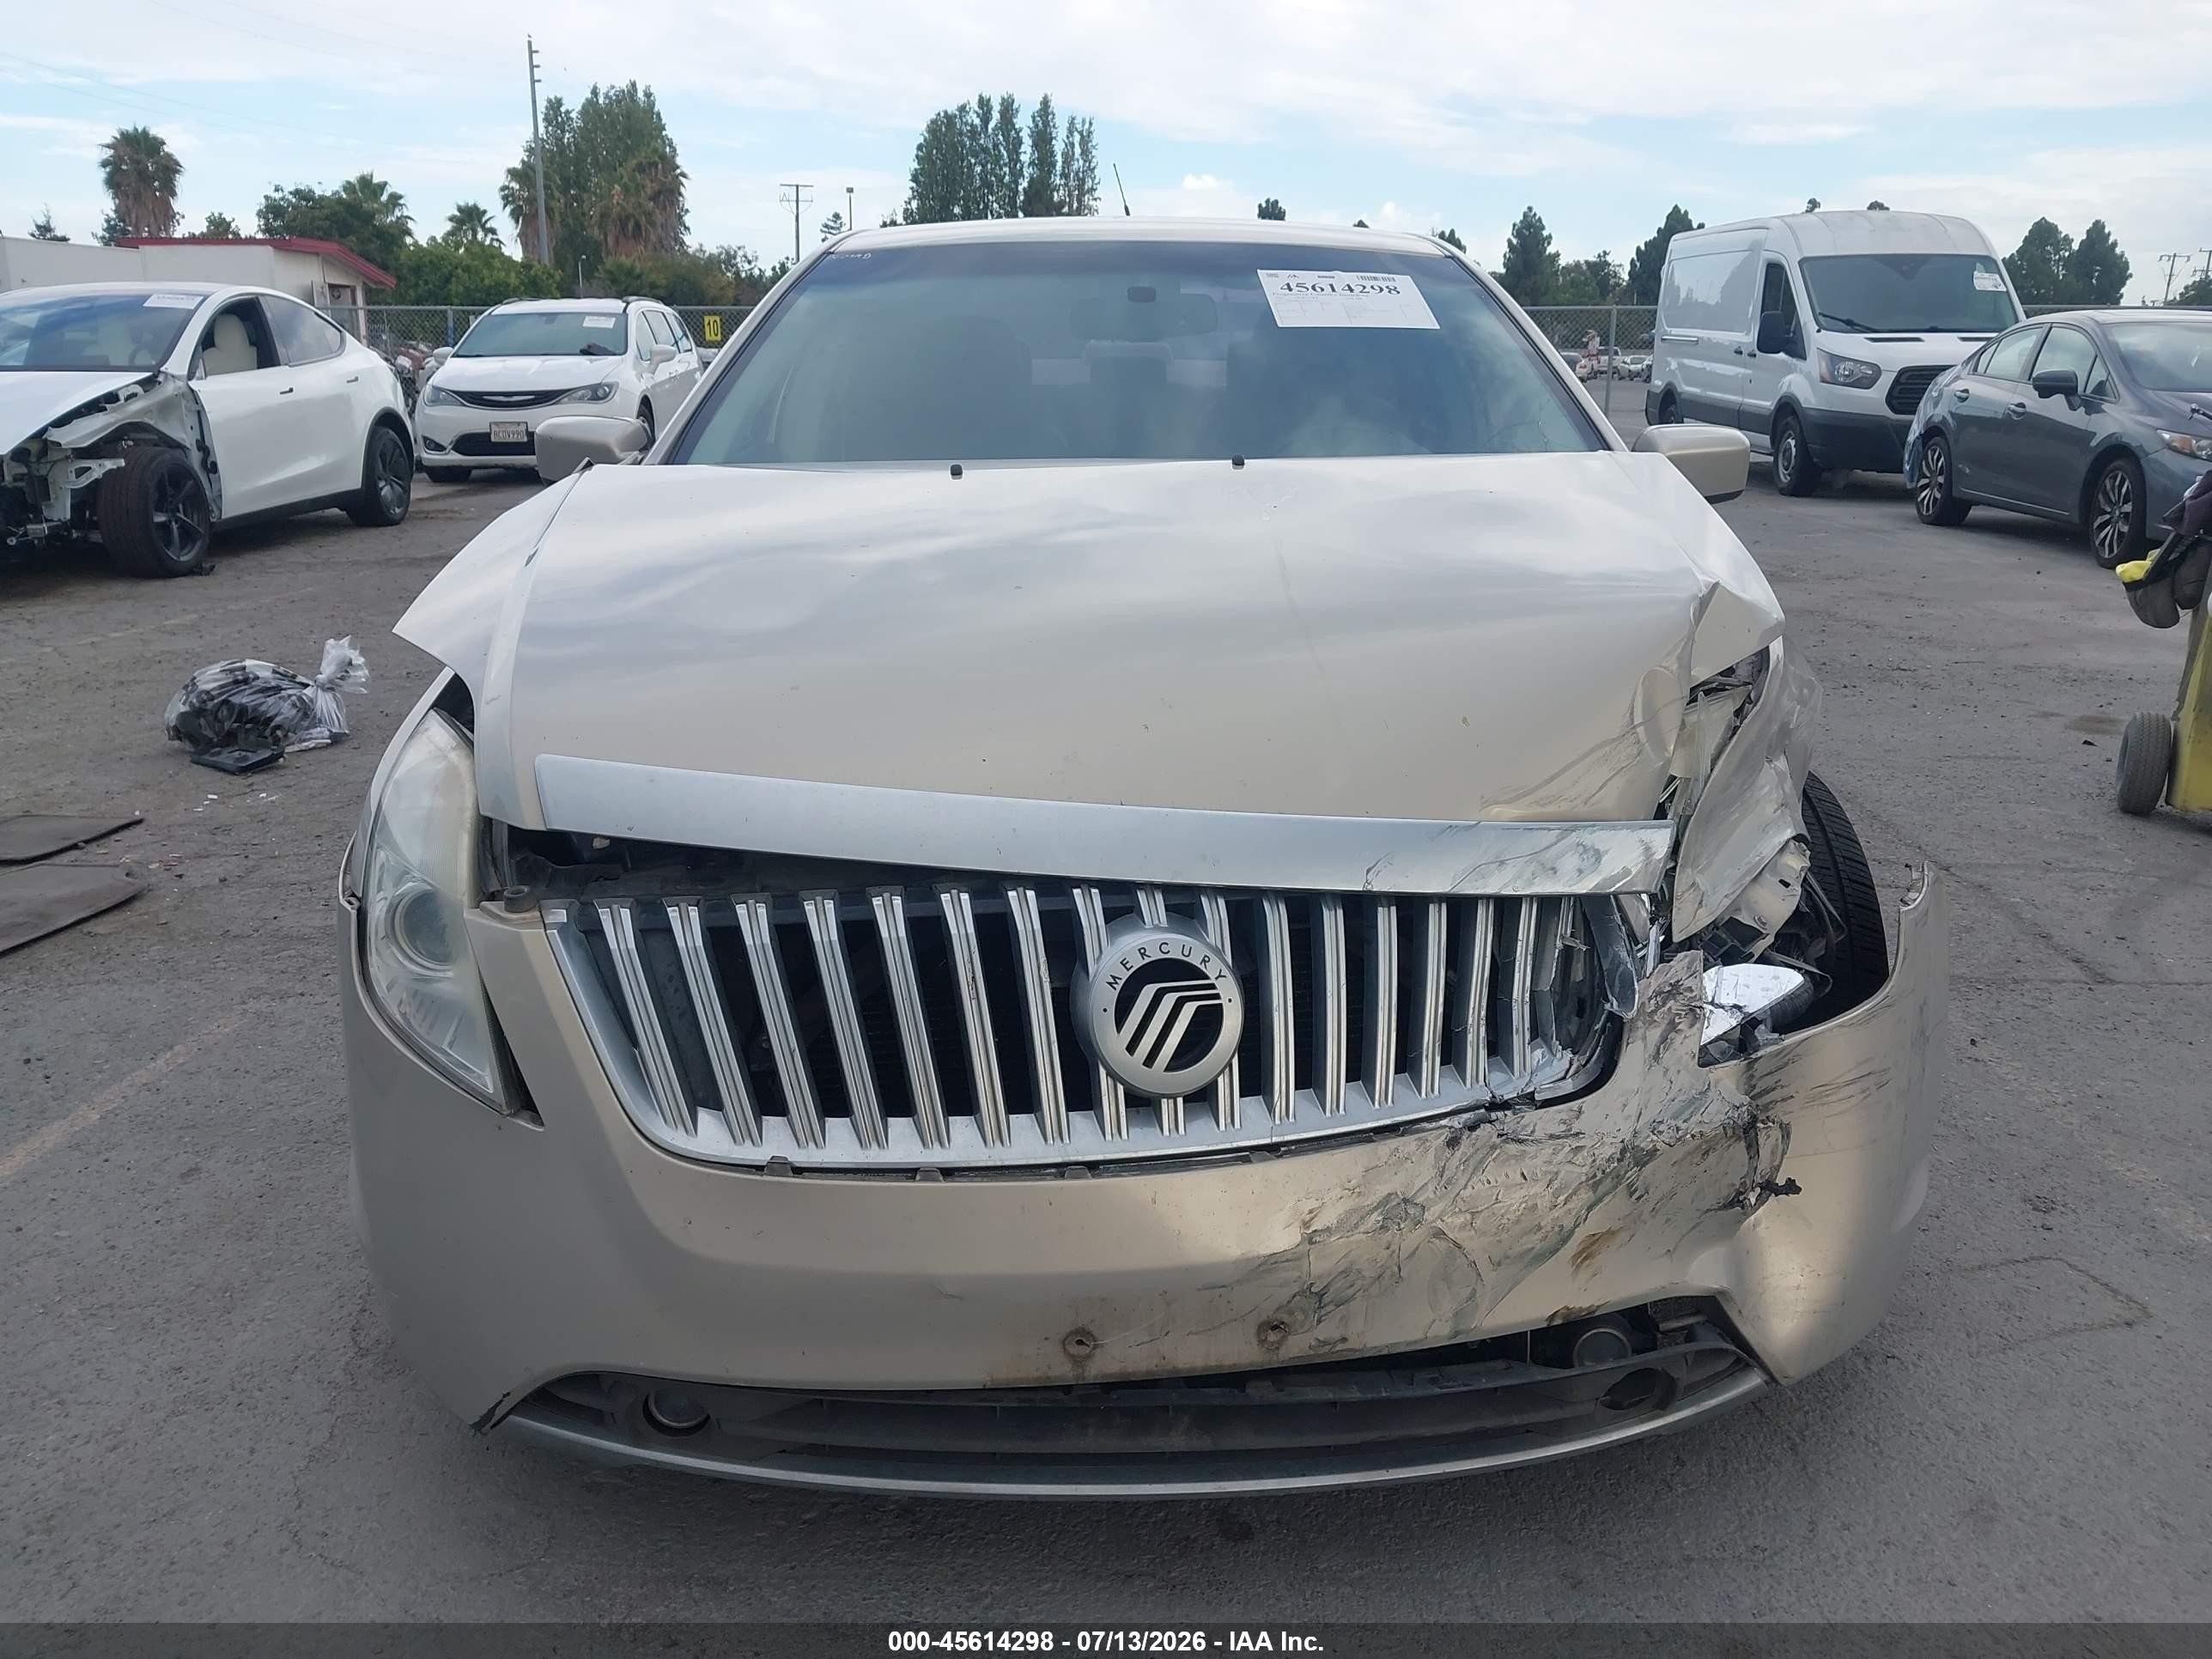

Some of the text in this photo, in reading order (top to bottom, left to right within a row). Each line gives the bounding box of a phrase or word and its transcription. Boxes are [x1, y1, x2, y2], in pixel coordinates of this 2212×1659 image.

[1279, 282, 1401, 295] 45614298
[706, 319, 719, 337] 10
[1105, 941, 1227, 991] MERCURY
